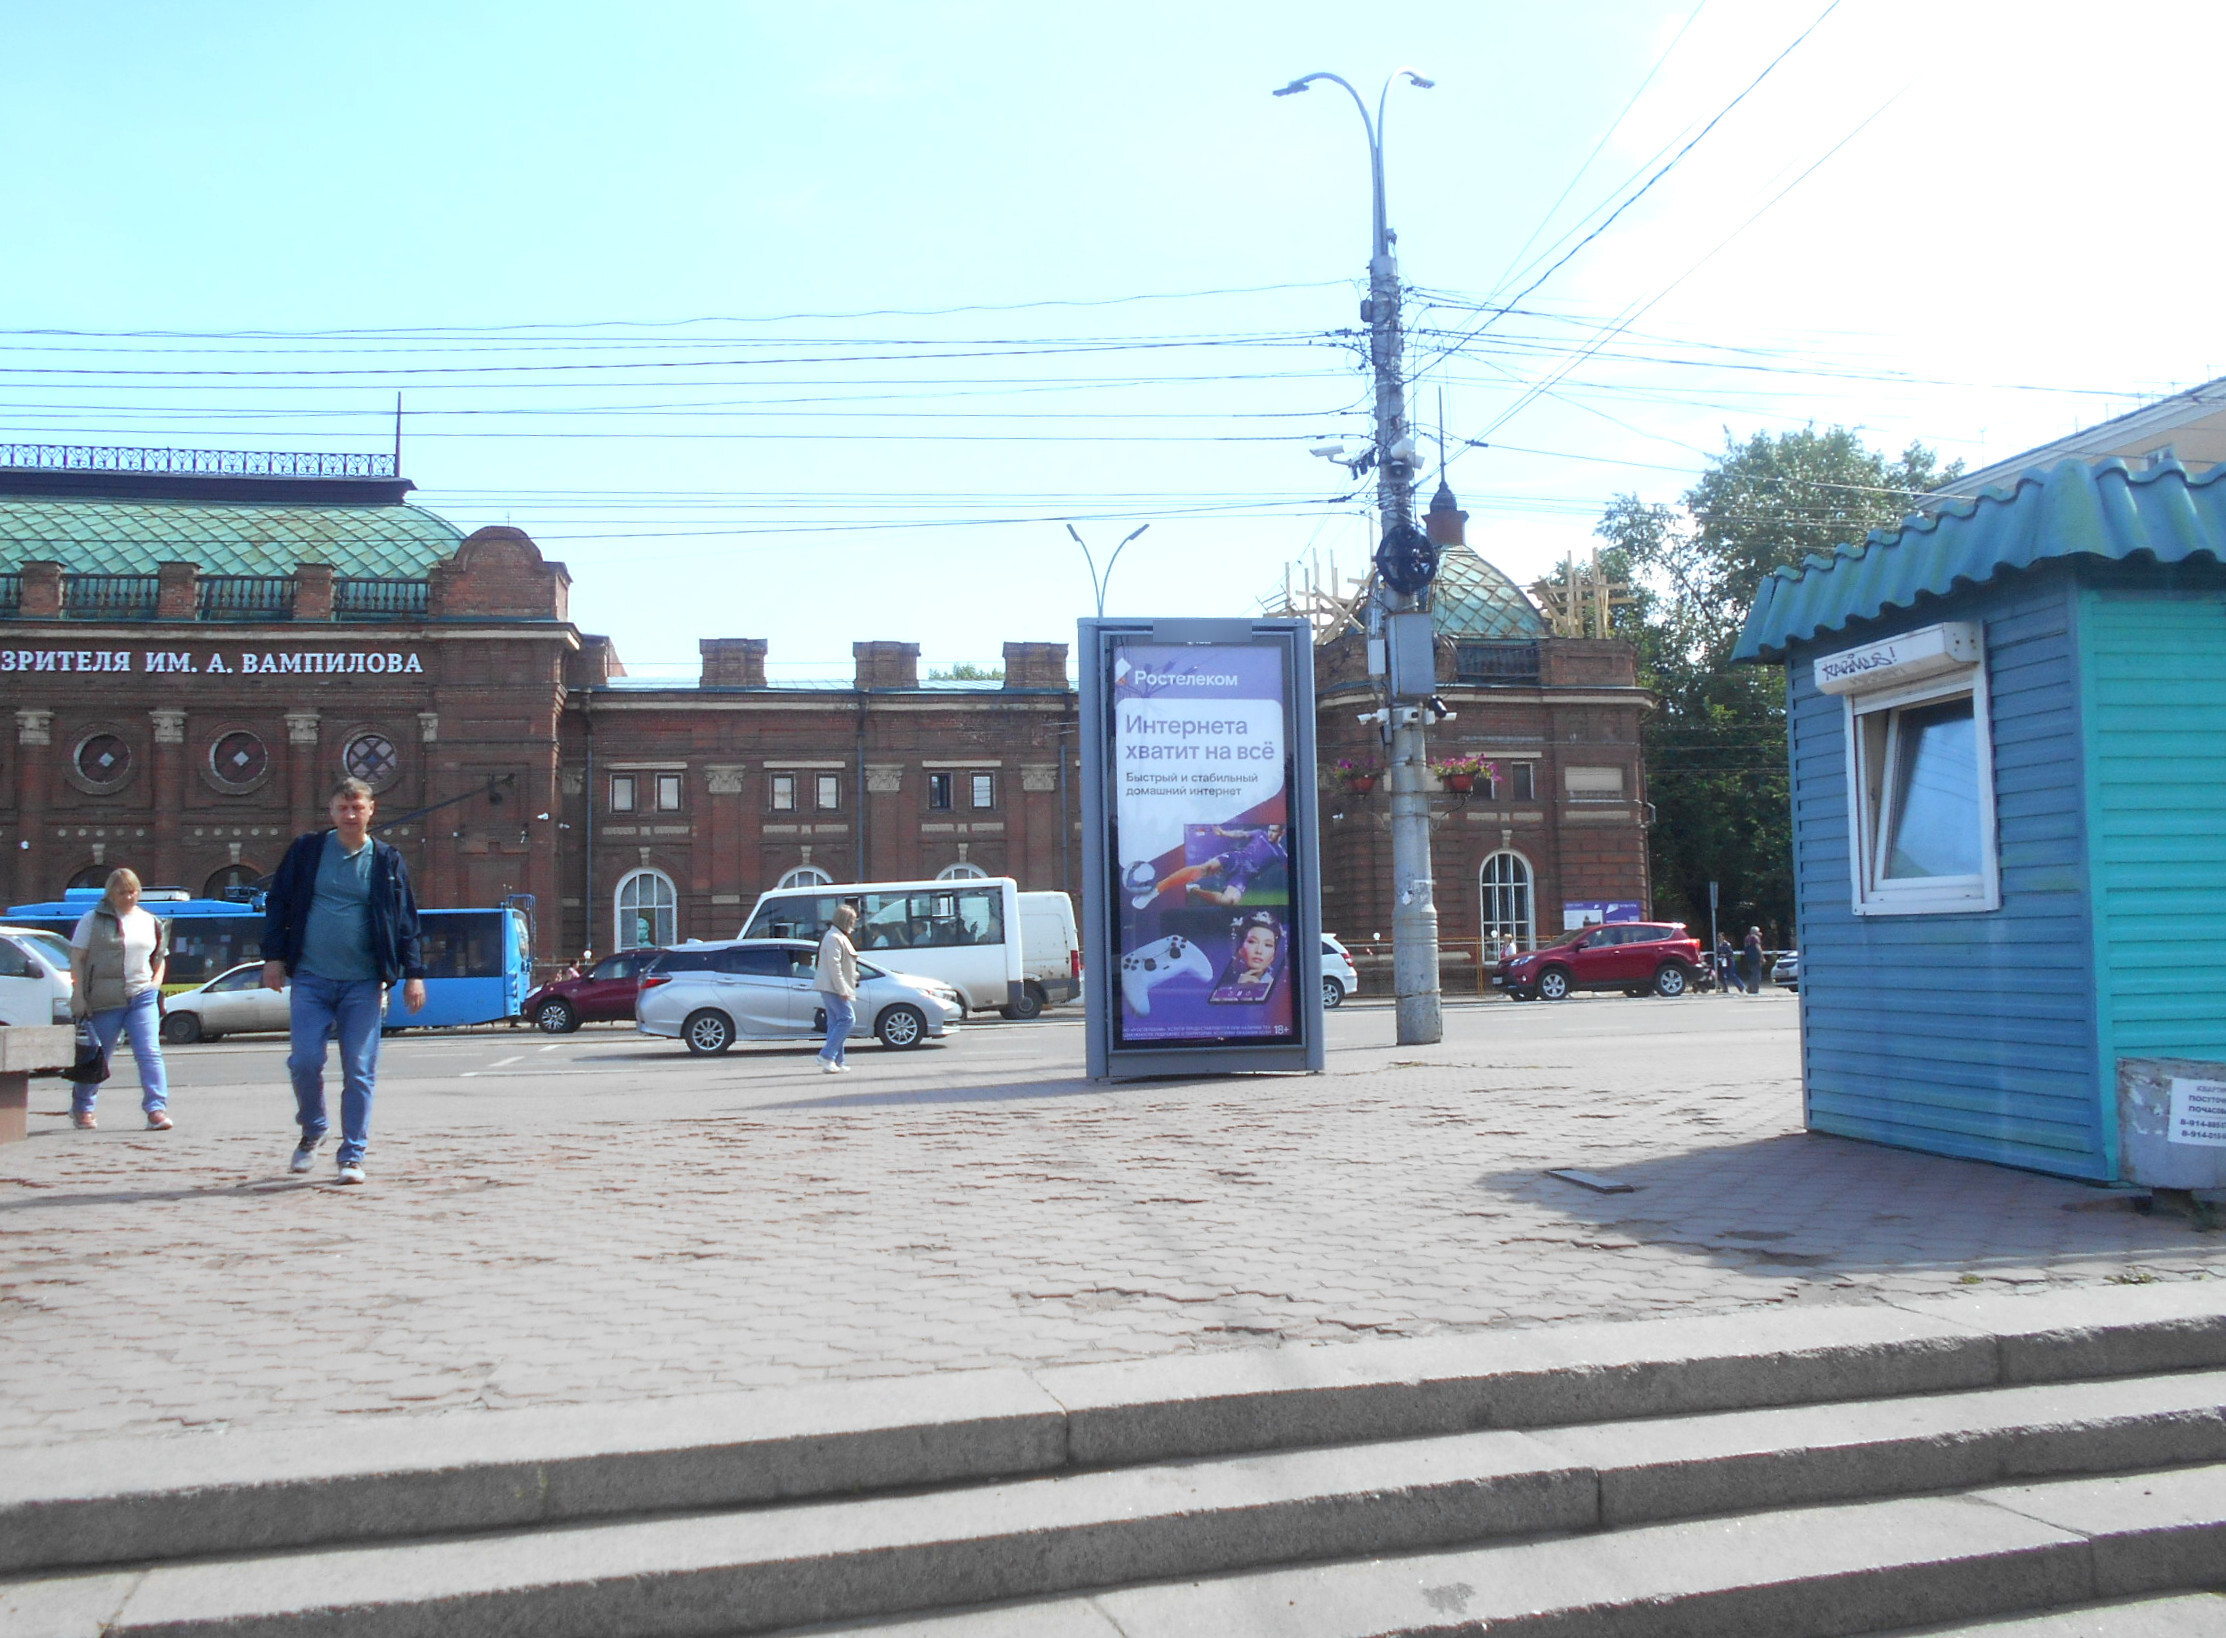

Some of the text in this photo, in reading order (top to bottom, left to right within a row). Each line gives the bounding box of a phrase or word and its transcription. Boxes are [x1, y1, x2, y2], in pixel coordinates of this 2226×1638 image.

[1, 650, 424, 674] ЗРИТЕЛЯ ИМ. А. ВАМПИЛОВА
[1134, 670, 1238, 687] Ростелеком
[1126, 714, 1248, 739] Интернета
[1125, 741, 1275, 760] хватит на всё
[1126, 772, 1258, 785] Быстрый и стабильный
[1126, 785, 1242, 798] домашний интернет
[1273, 1024, 1290, 1035] 18+
